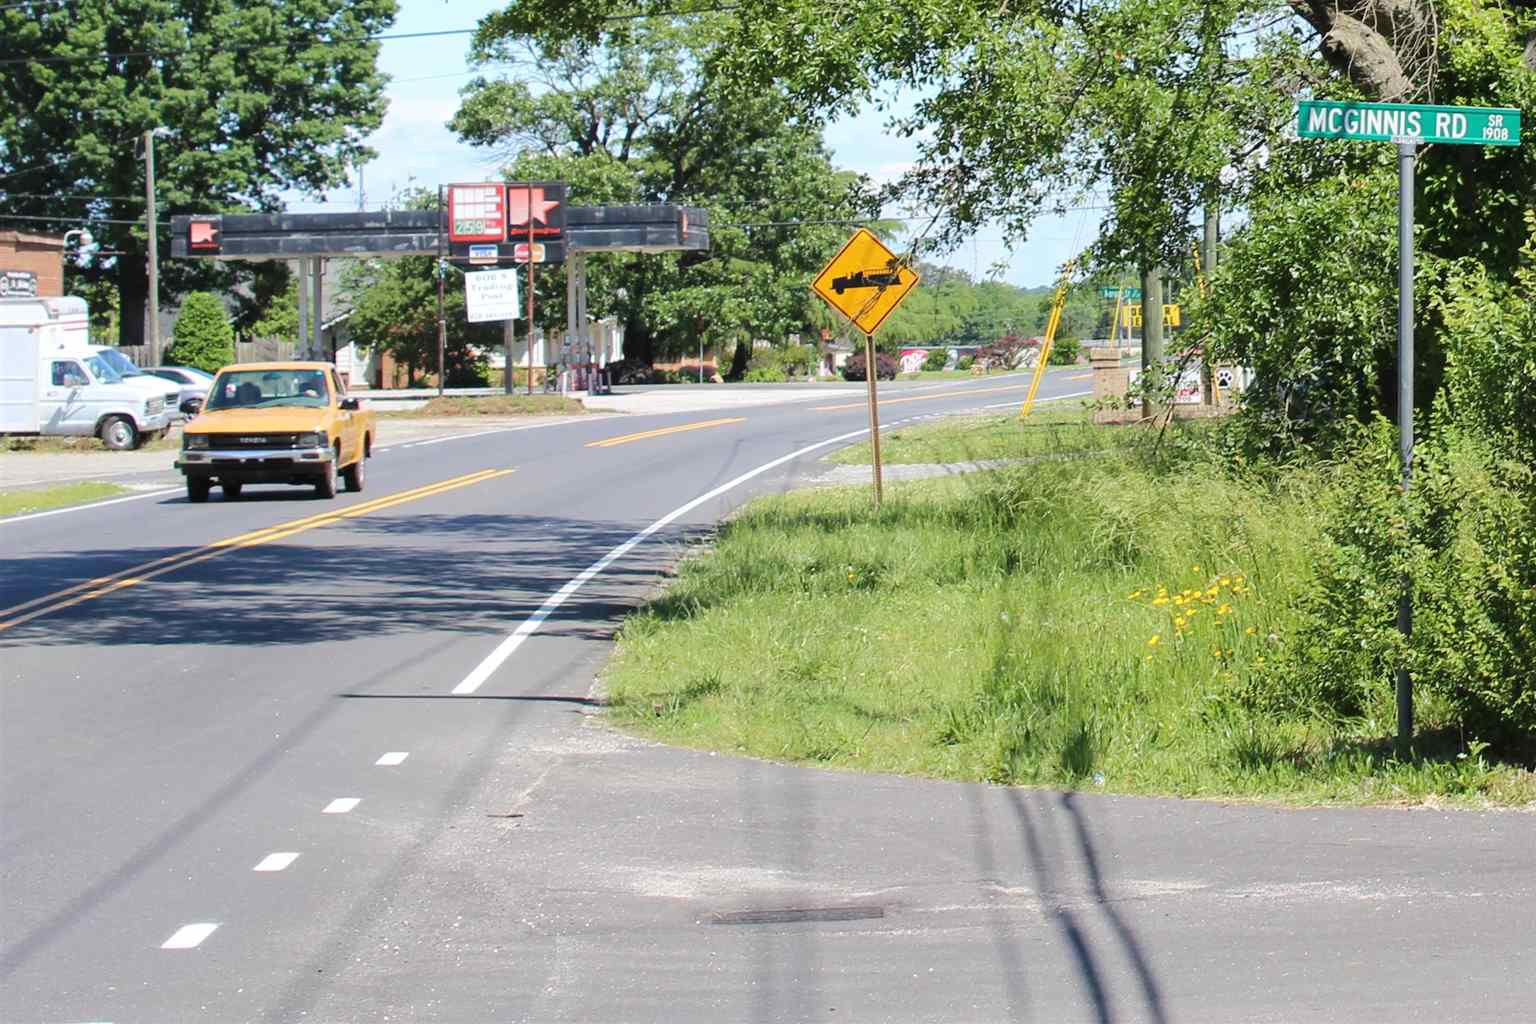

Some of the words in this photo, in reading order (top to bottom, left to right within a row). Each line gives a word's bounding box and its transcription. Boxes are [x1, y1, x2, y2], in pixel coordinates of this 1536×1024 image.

[1308, 107, 1421, 137] MCGINNIS
[1435, 112, 1467, 139] RD
[1488, 114, 1504, 127] SR
[1482, 127, 1509, 140] 1908
